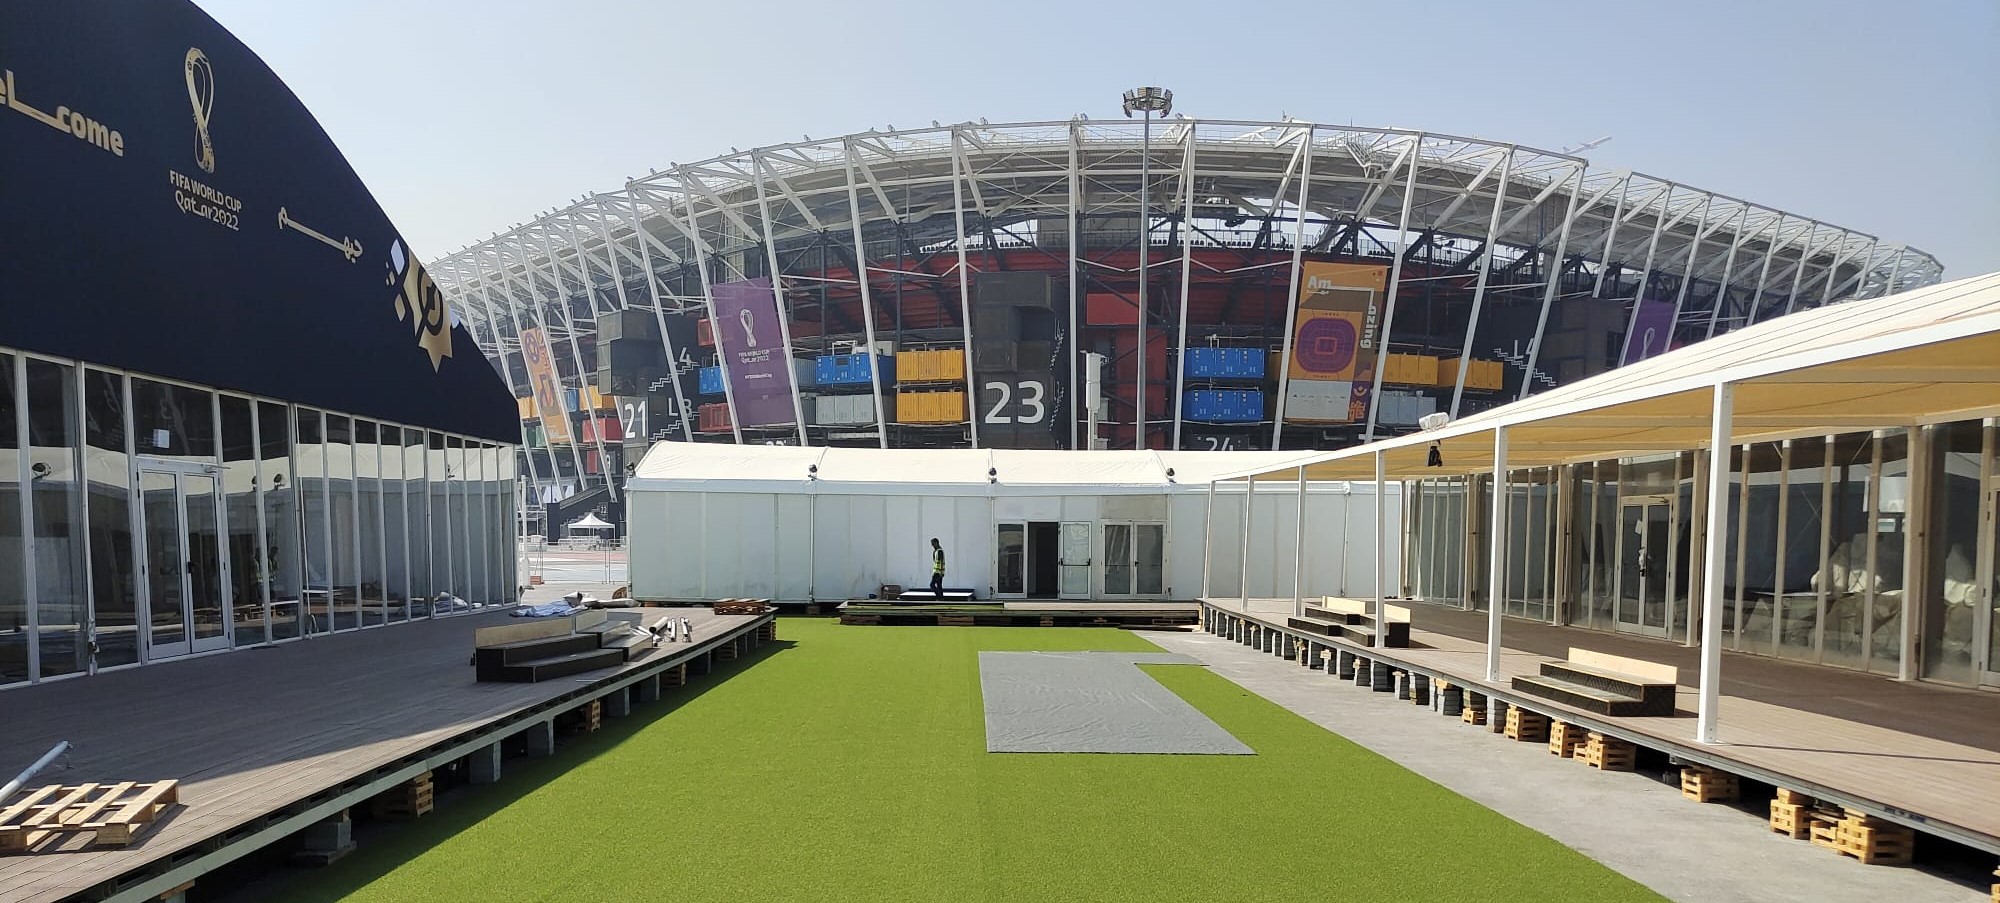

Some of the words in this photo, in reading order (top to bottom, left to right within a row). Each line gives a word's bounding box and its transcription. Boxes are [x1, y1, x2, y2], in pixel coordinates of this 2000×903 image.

[169, 170, 191, 191] FIFA
[191, 179, 224, 205] WORLD
[225, 195, 242, 213] CUP
[624, 400, 646, 439] 21
[984, 381, 1045, 424] 23
